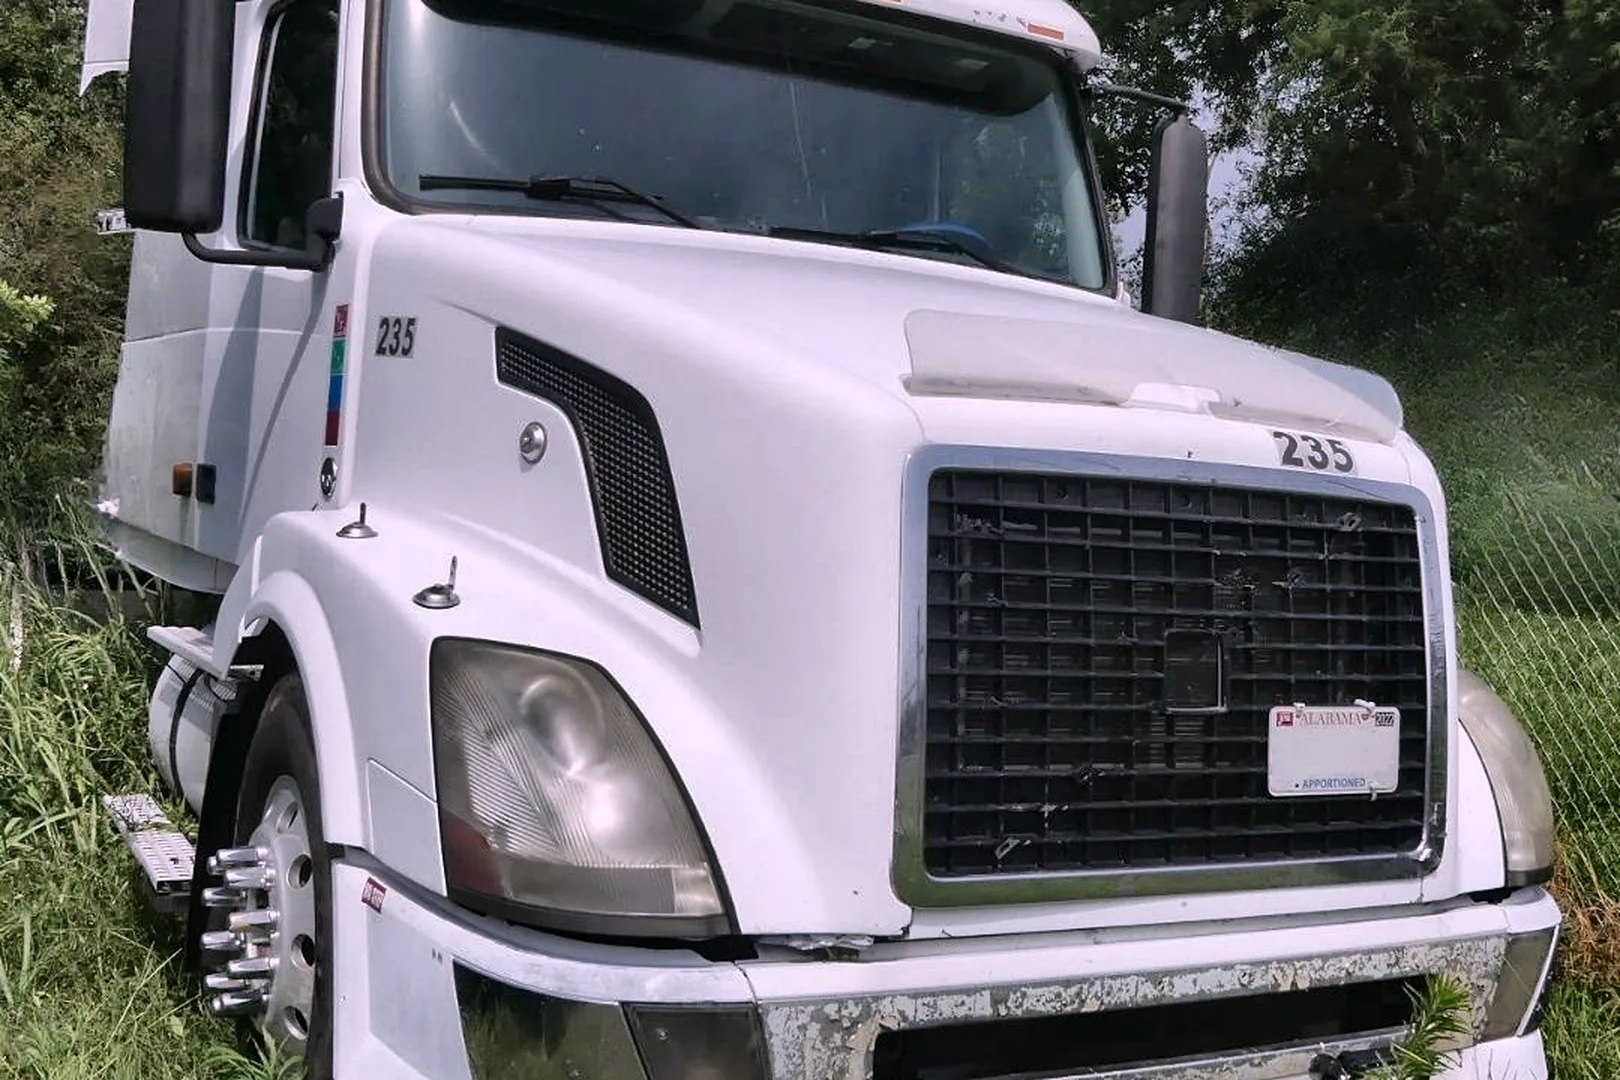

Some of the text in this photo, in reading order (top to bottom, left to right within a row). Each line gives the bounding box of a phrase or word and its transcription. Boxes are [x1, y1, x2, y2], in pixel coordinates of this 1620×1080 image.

[376, 317, 416, 356] 235
[1273, 431, 1353, 473] 235
[1300, 711, 1361, 725] ALABAMA
[1302, 778, 1366, 789] APPORTIONED
